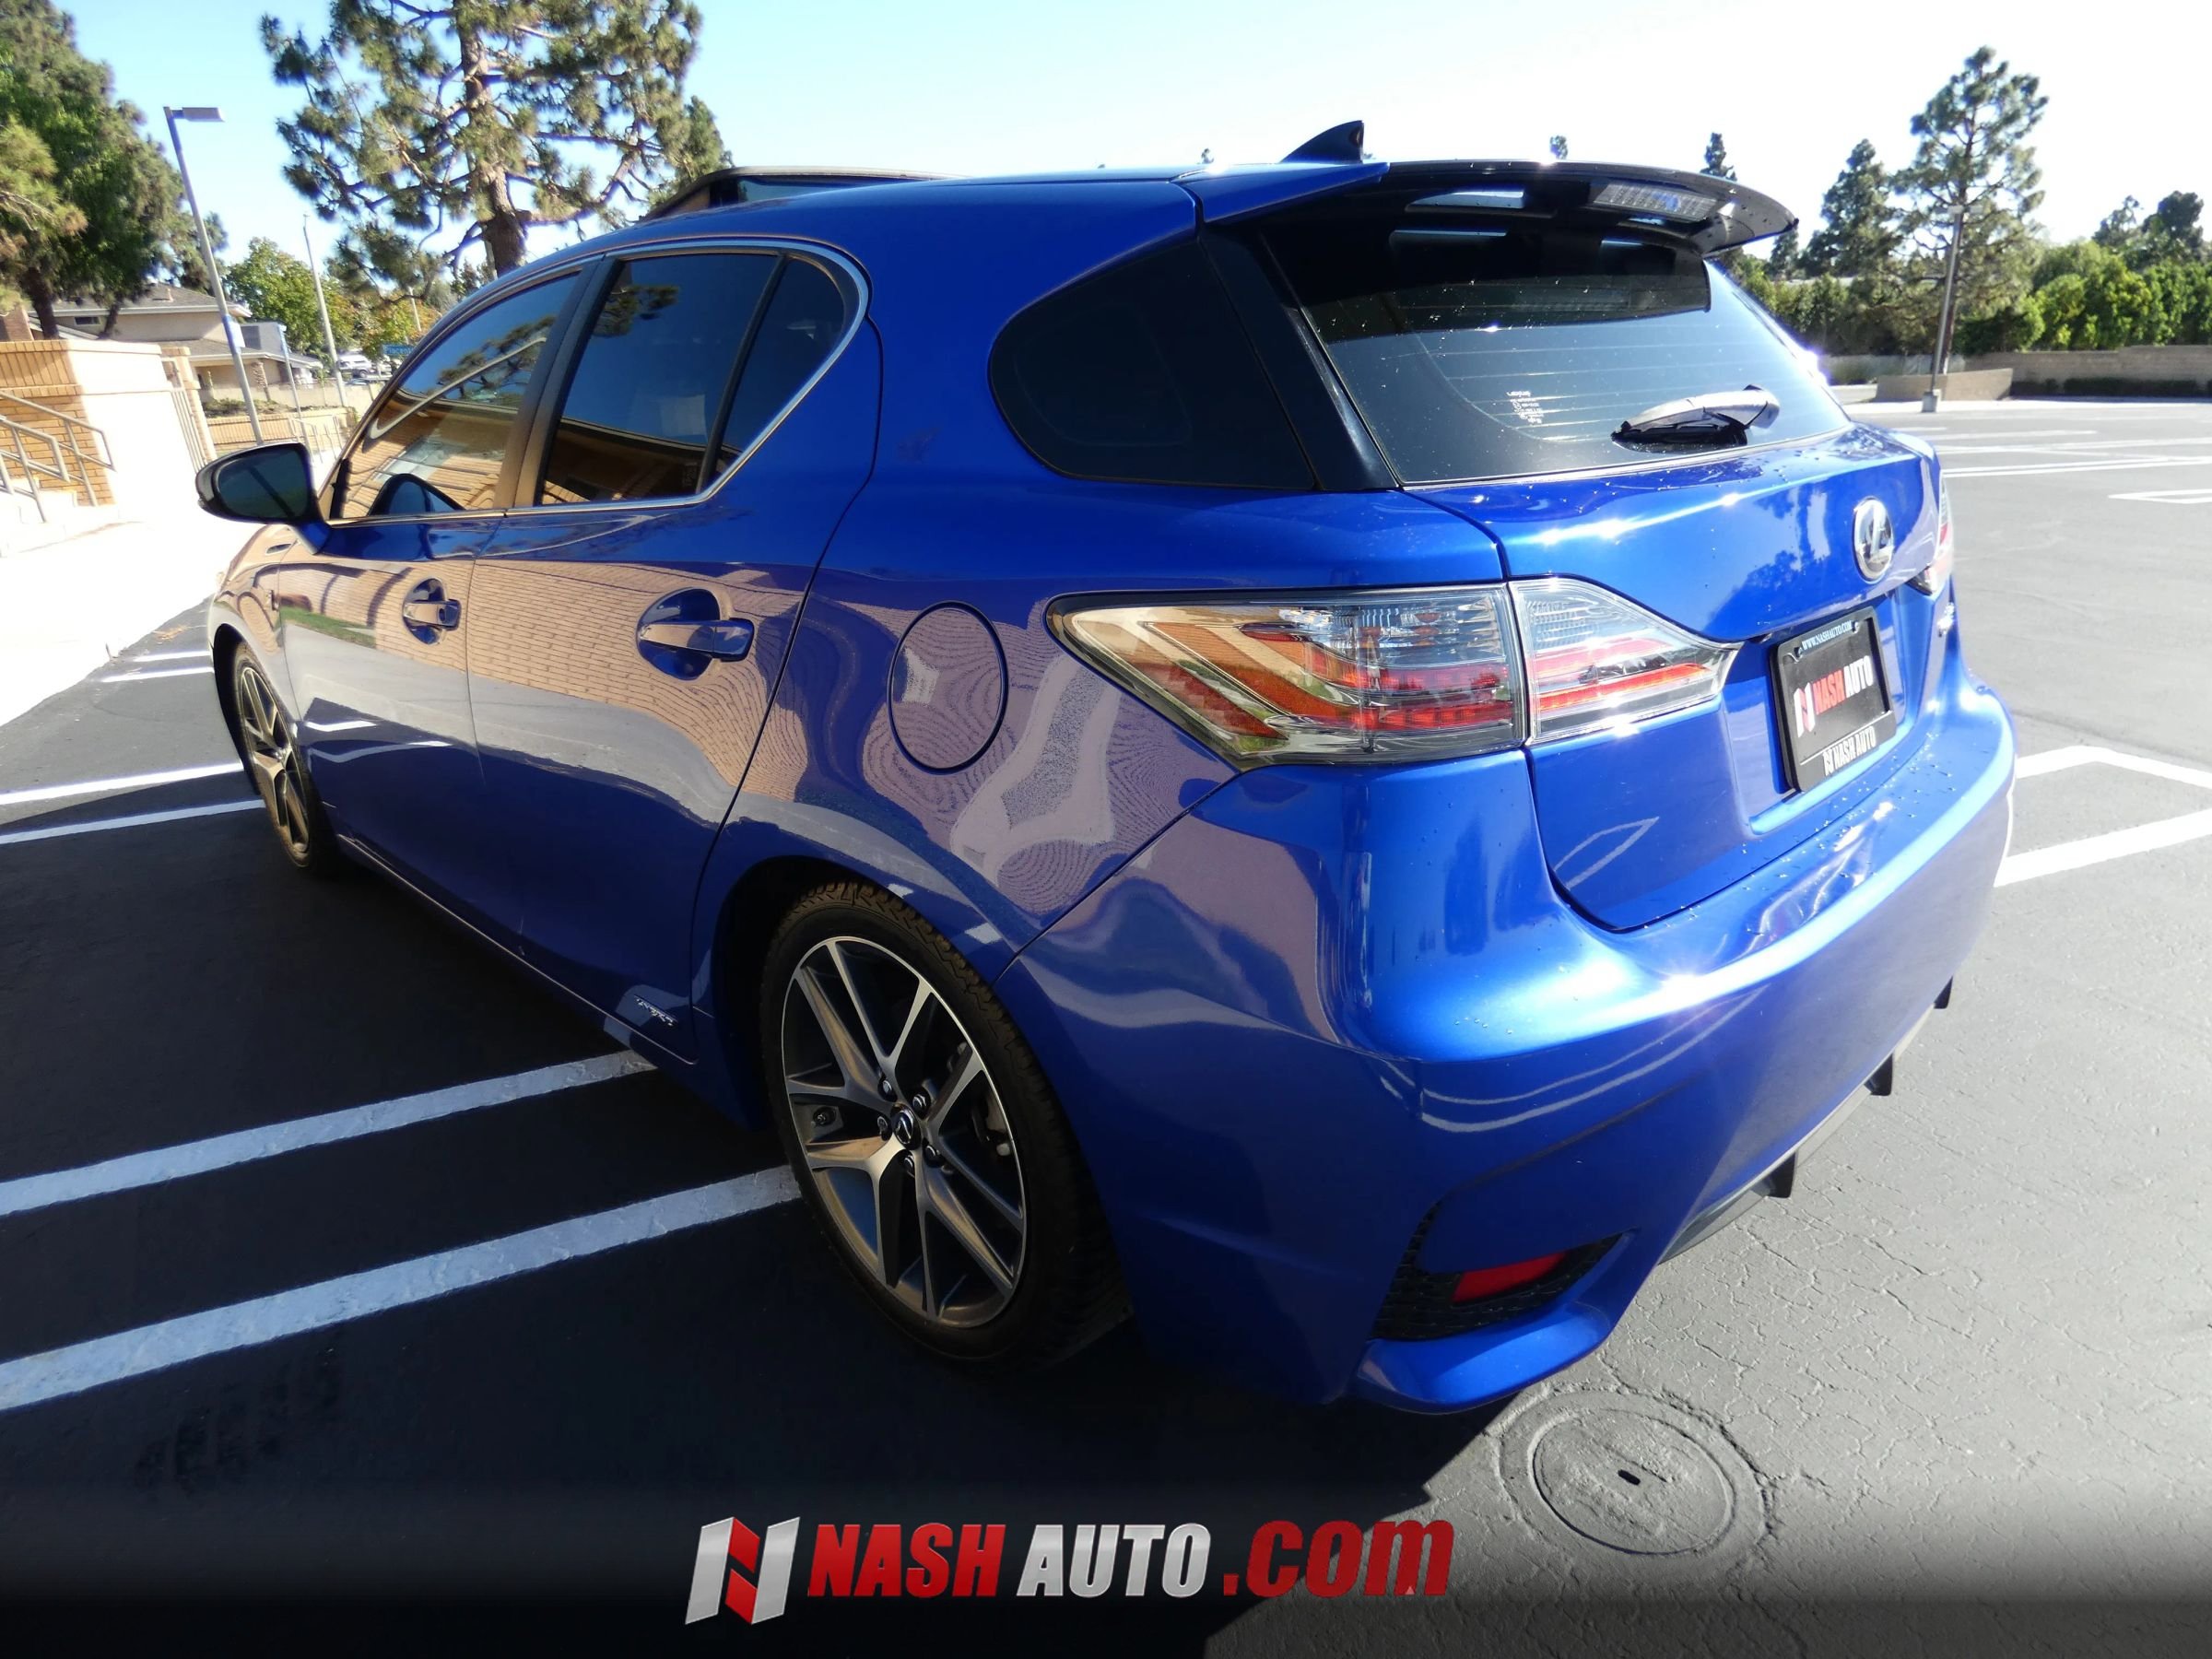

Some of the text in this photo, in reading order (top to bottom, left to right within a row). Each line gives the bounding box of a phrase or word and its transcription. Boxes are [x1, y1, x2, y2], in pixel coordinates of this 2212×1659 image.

[1812, 669, 1847, 715] NASH
[1844, 655, 1874, 698] AUTO
[1832, 736, 1856, 771] NASH
[1854, 725, 1877, 756] AUTO
